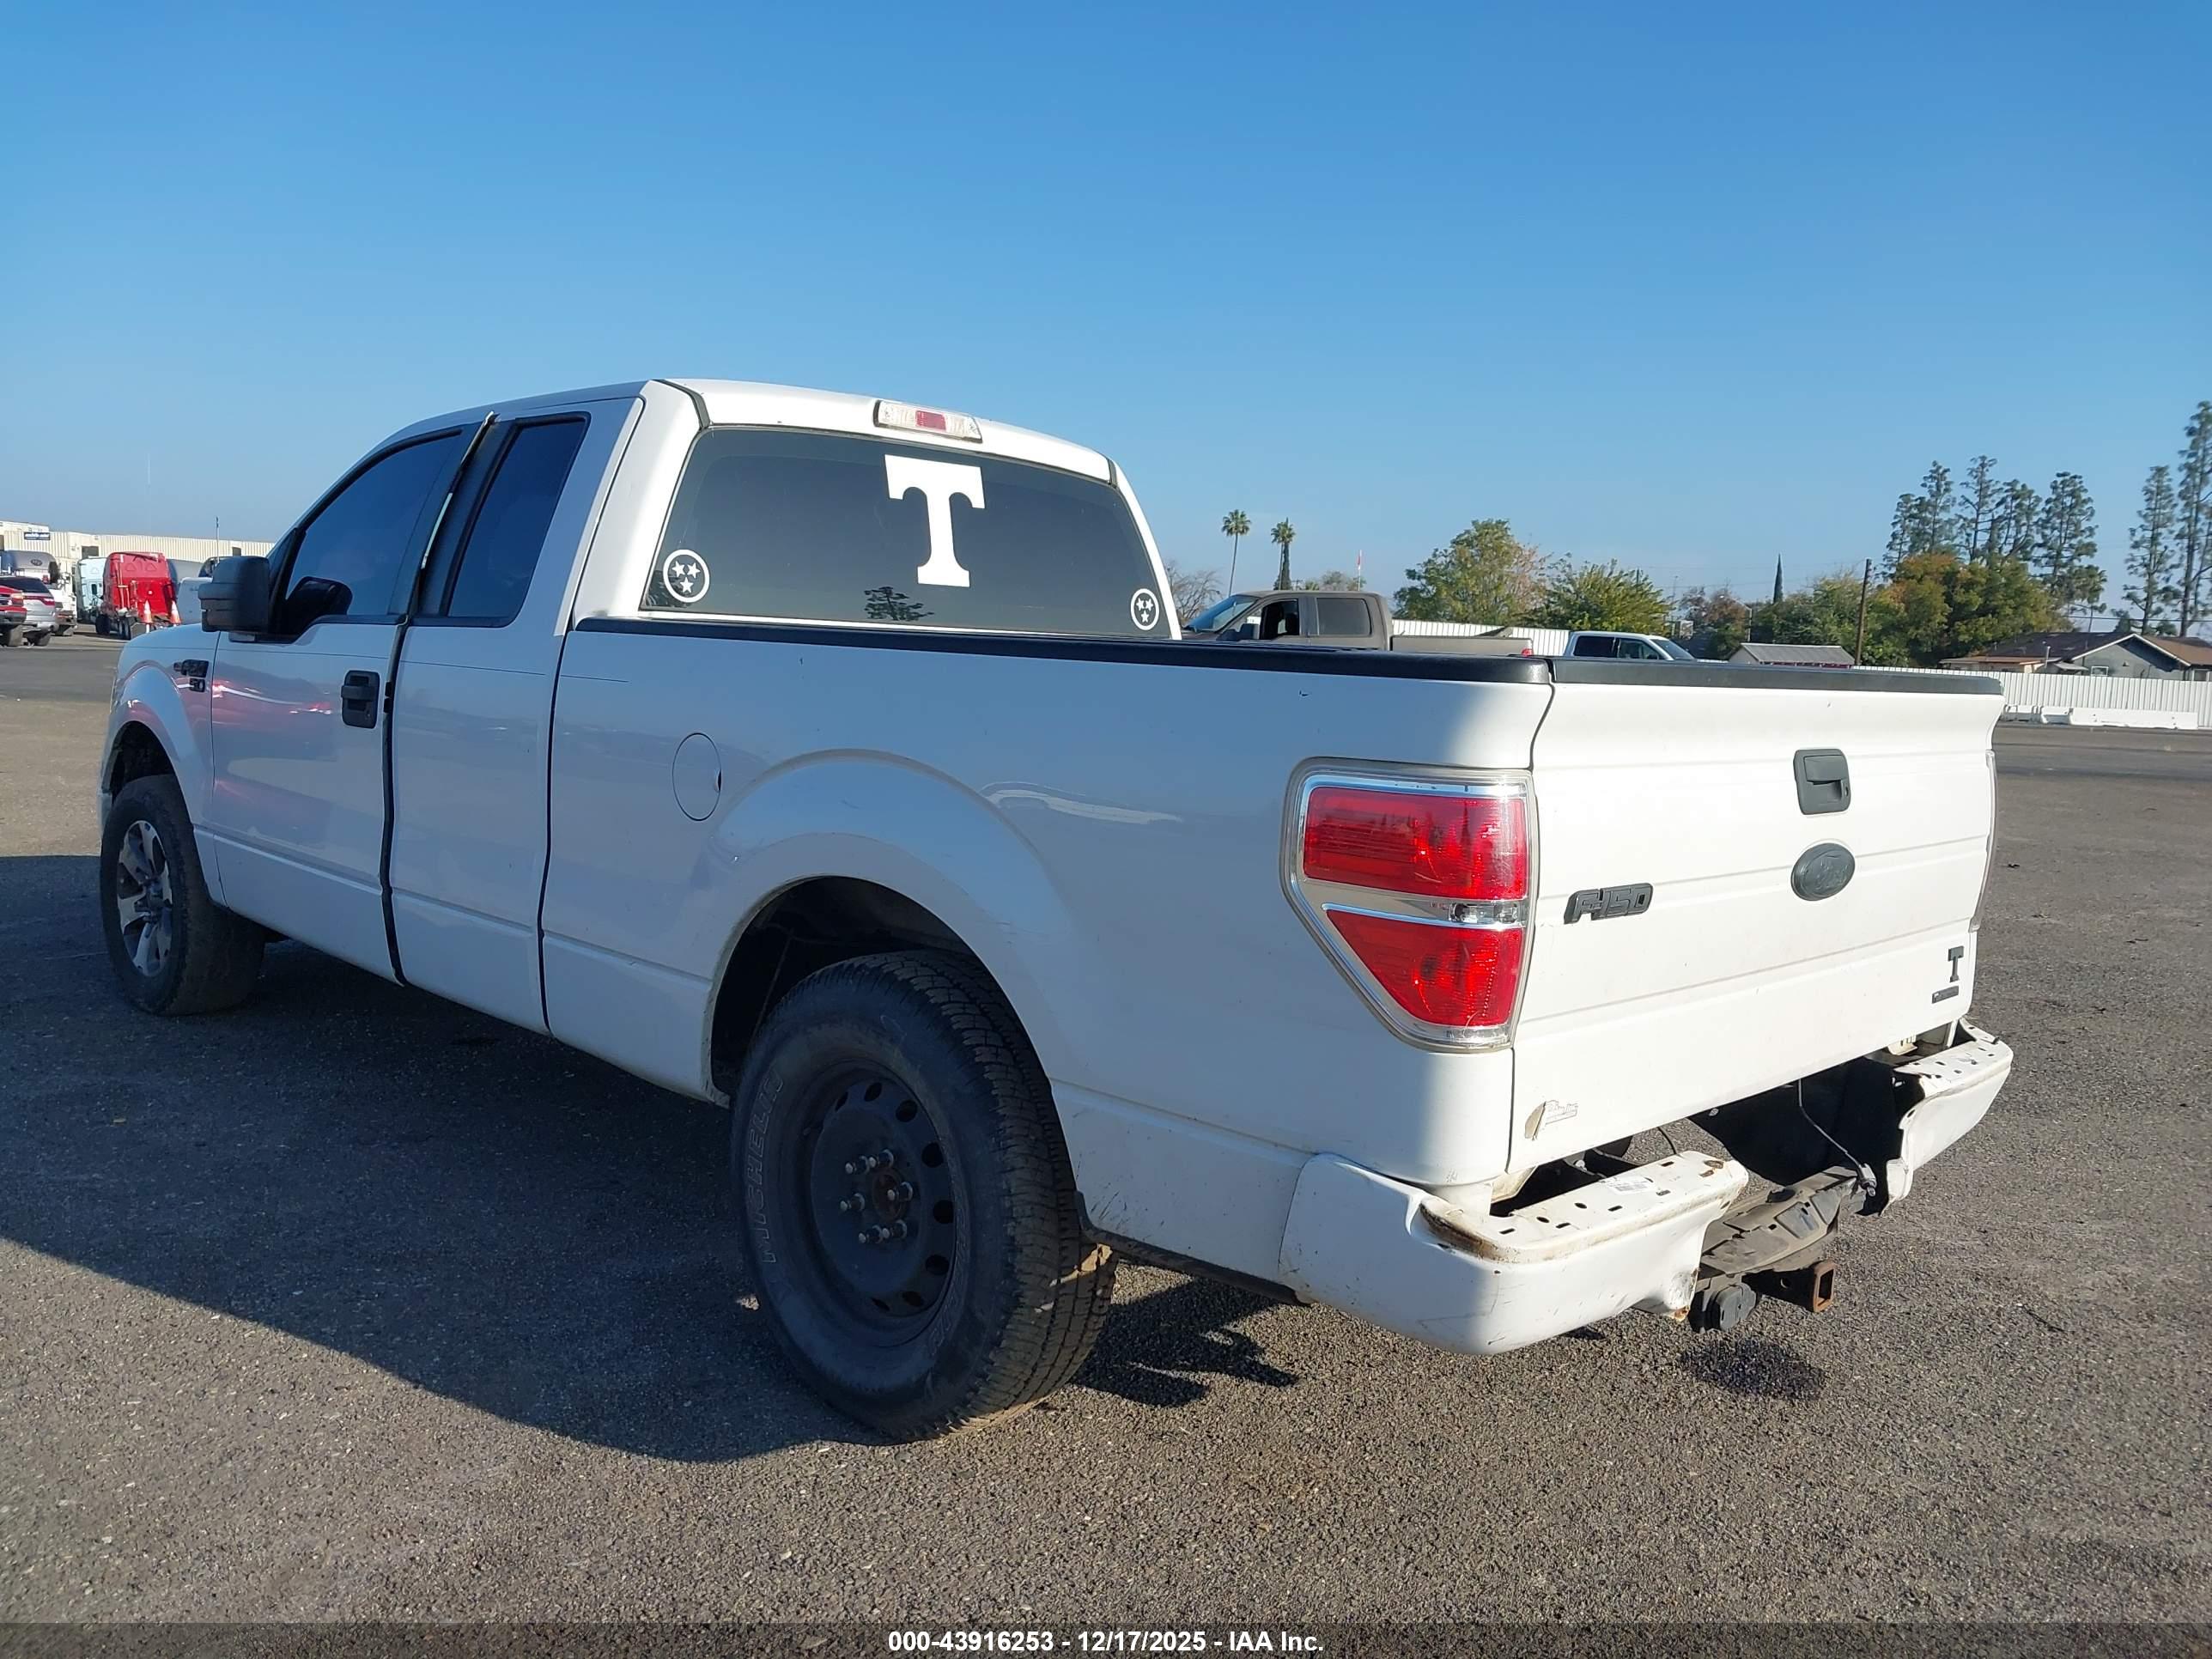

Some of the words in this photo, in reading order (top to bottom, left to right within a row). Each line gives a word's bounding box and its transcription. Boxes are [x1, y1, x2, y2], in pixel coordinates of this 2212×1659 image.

[884, 454, 986, 587] T
[1948, 945, 1964, 982] T
[746, 1065, 784, 1264] MICHELIN
